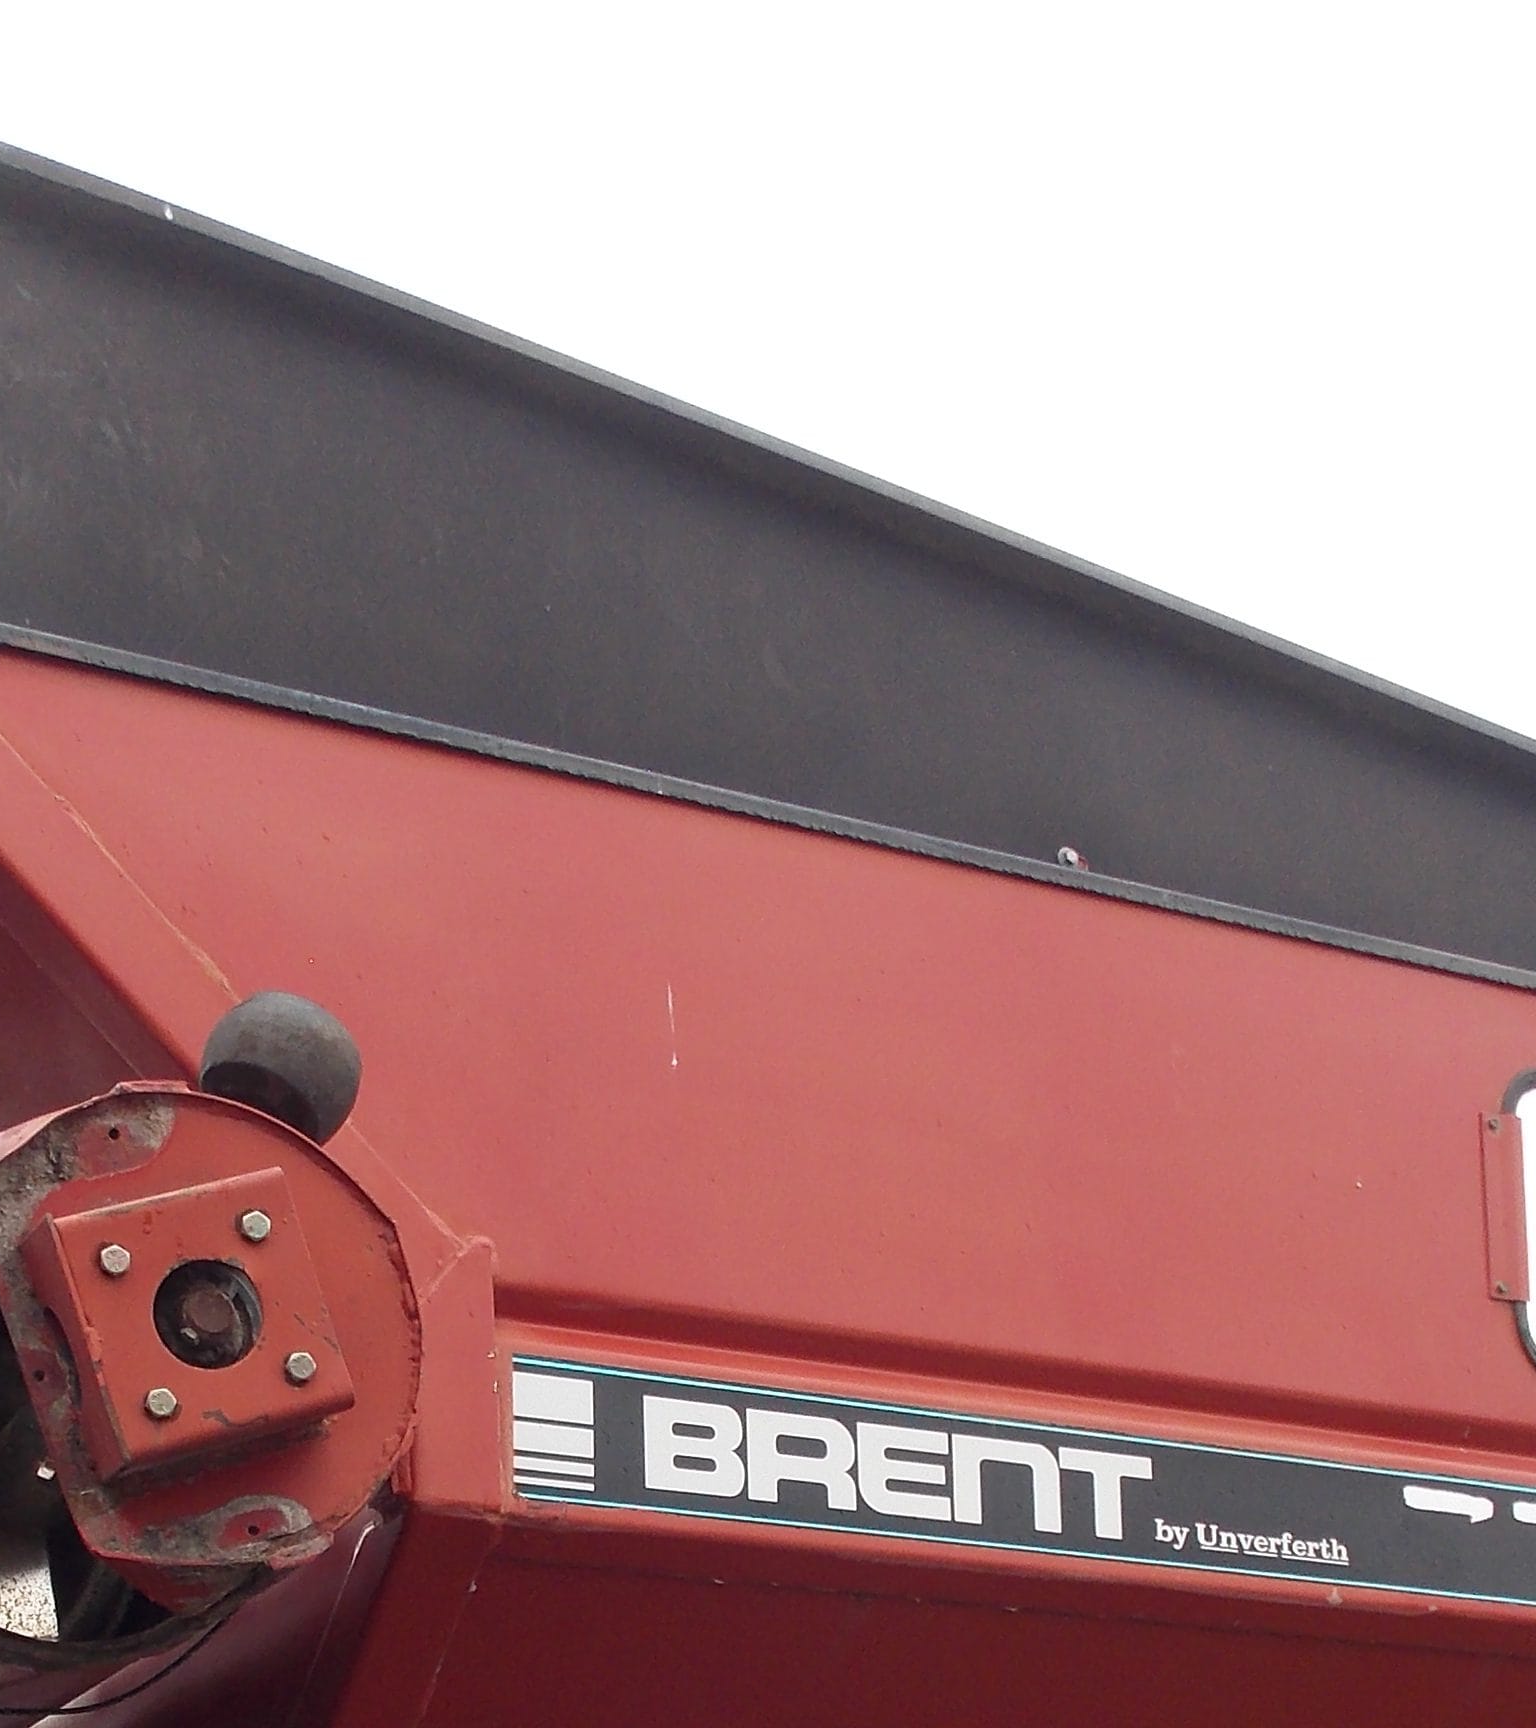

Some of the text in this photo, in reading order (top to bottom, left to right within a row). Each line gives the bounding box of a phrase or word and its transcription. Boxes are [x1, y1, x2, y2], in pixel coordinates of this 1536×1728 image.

[642, 1394, 1153, 1540] BRENT
[1155, 1518, 1189, 1550] by
[1195, 1522, 1350, 1565] Unverferth
